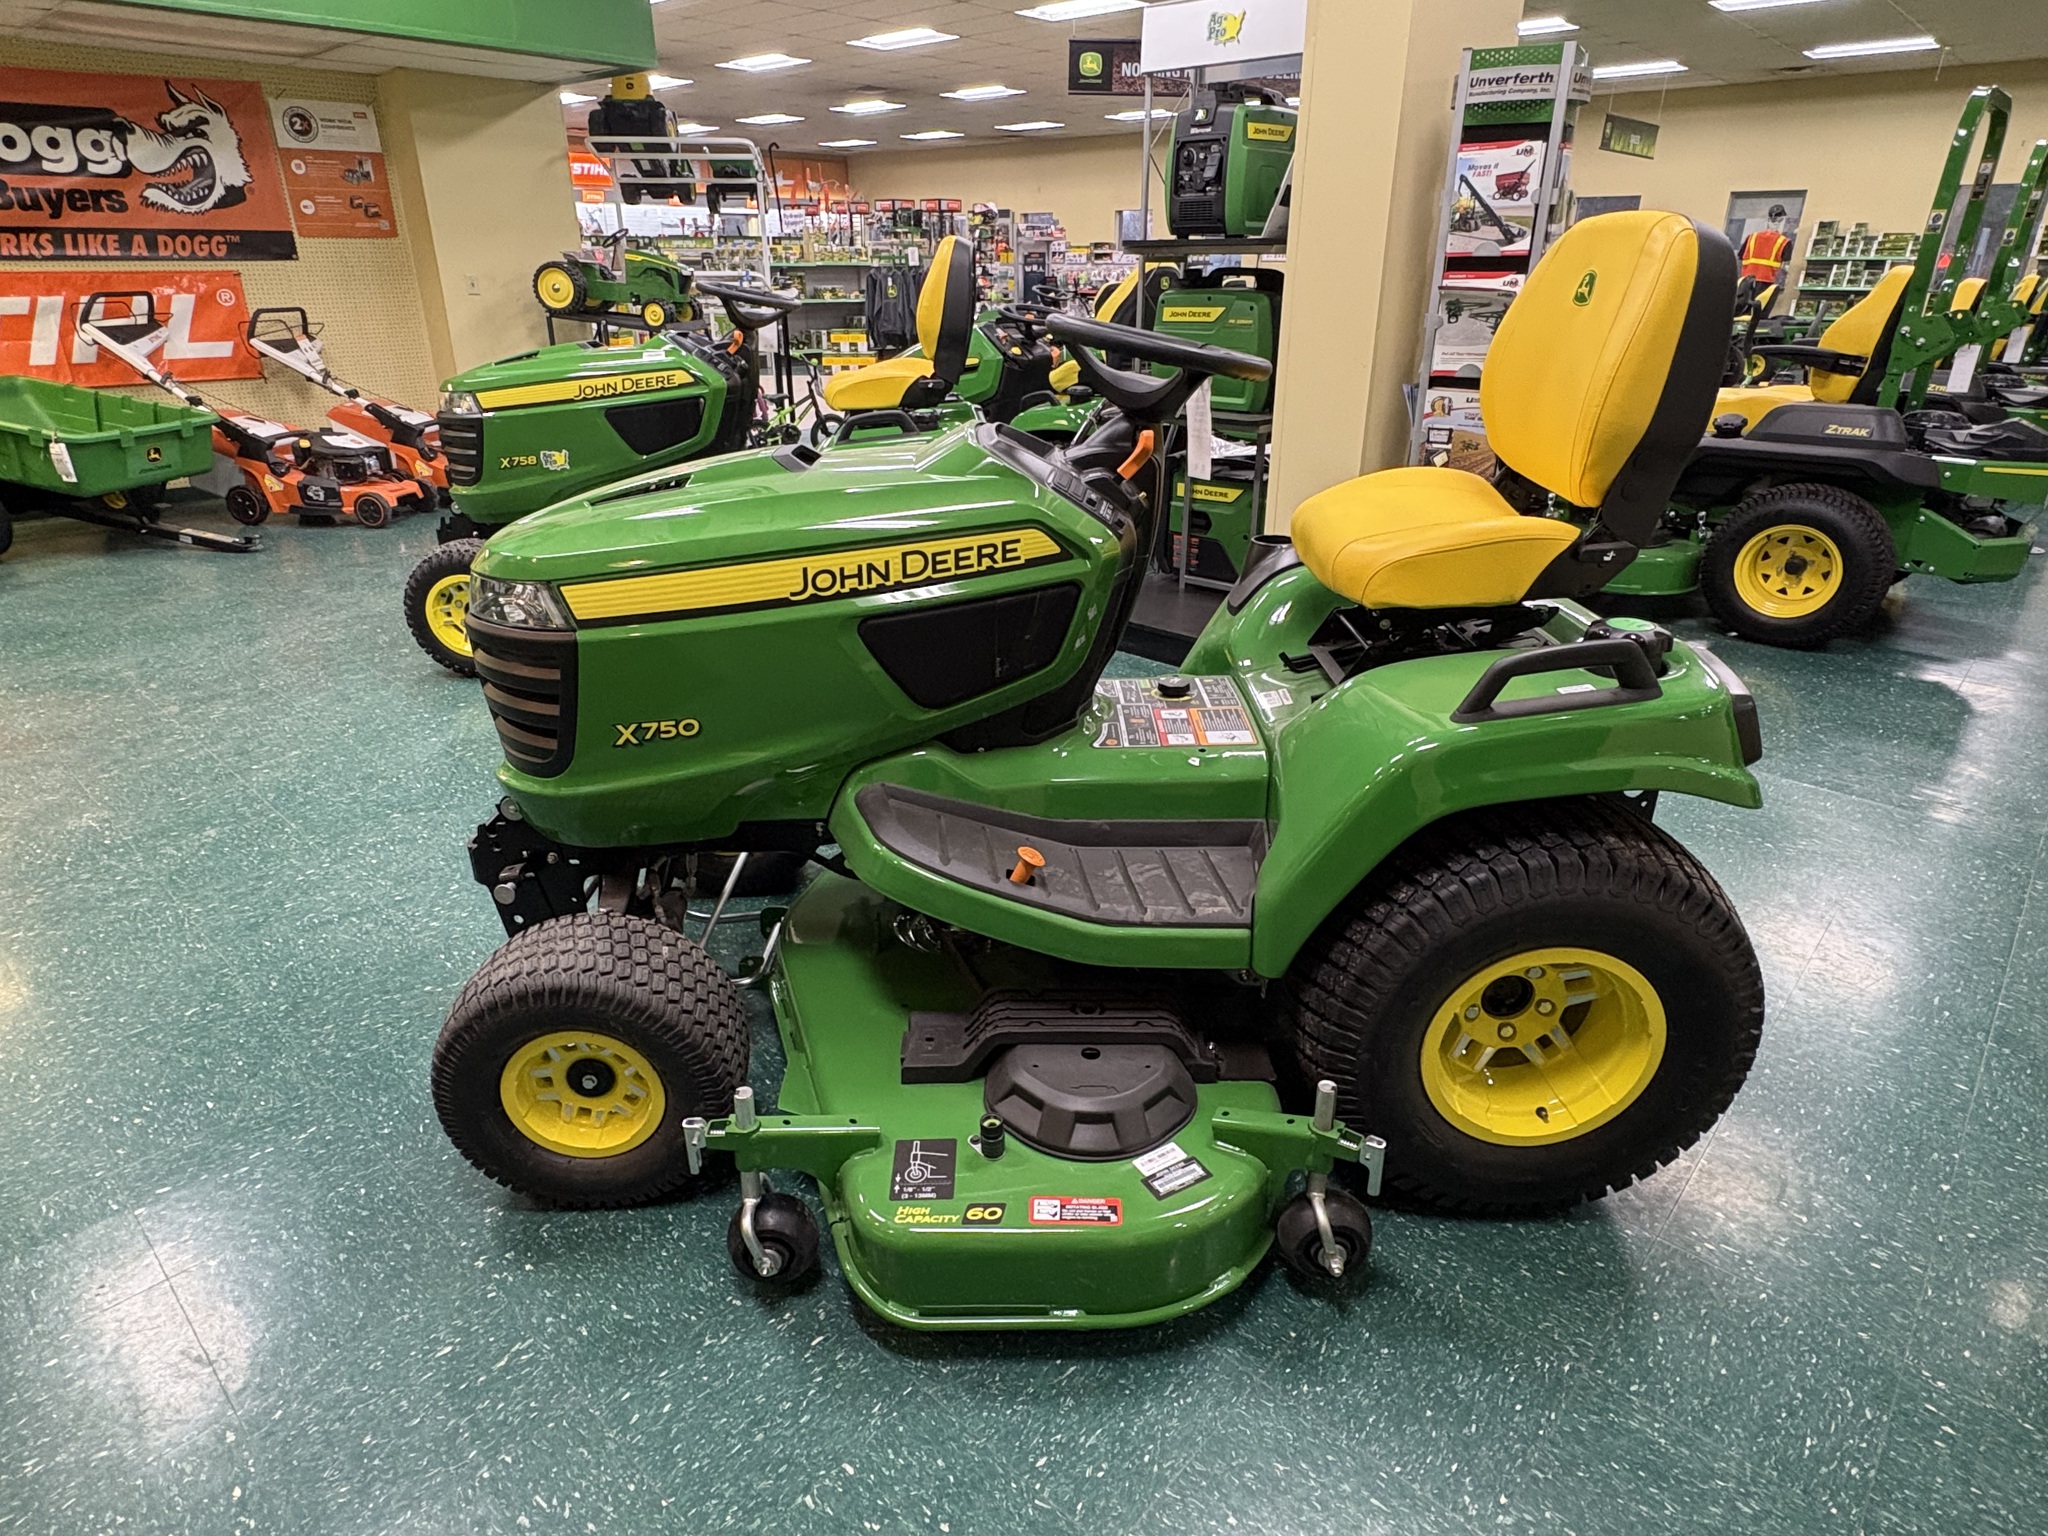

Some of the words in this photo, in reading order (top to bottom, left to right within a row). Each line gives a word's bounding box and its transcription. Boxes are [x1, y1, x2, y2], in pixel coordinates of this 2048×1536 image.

[1206, 26, 1226, 41] Pro
[1470, 72, 1554, 88] Unverferth
[1508, 87, 1537, 95] Company,
[1253, 127, 1267, 135] JOHN
[1268, 128, 1285, 137] DEERE
[64, 233, 120, 256] LIKE
[131, 234, 149, 256] A
[574, 382, 618, 398] JOHN
[621, 374, 677, 391] DEERE
[1825, 424, 1871, 437] ZTRAK
[500, 455, 537, 469] X758
[1204, 489, 1228, 498] DEERE
[790, 560, 890, 597] JOHN
[901, 538, 1021, 579] DEERE
[615, 718, 700, 746] X750
[897, 1206, 931, 1215] HIGH
[966, 1207, 1003, 1220] 60
[894, 1215, 960, 1223] CAPACITY
